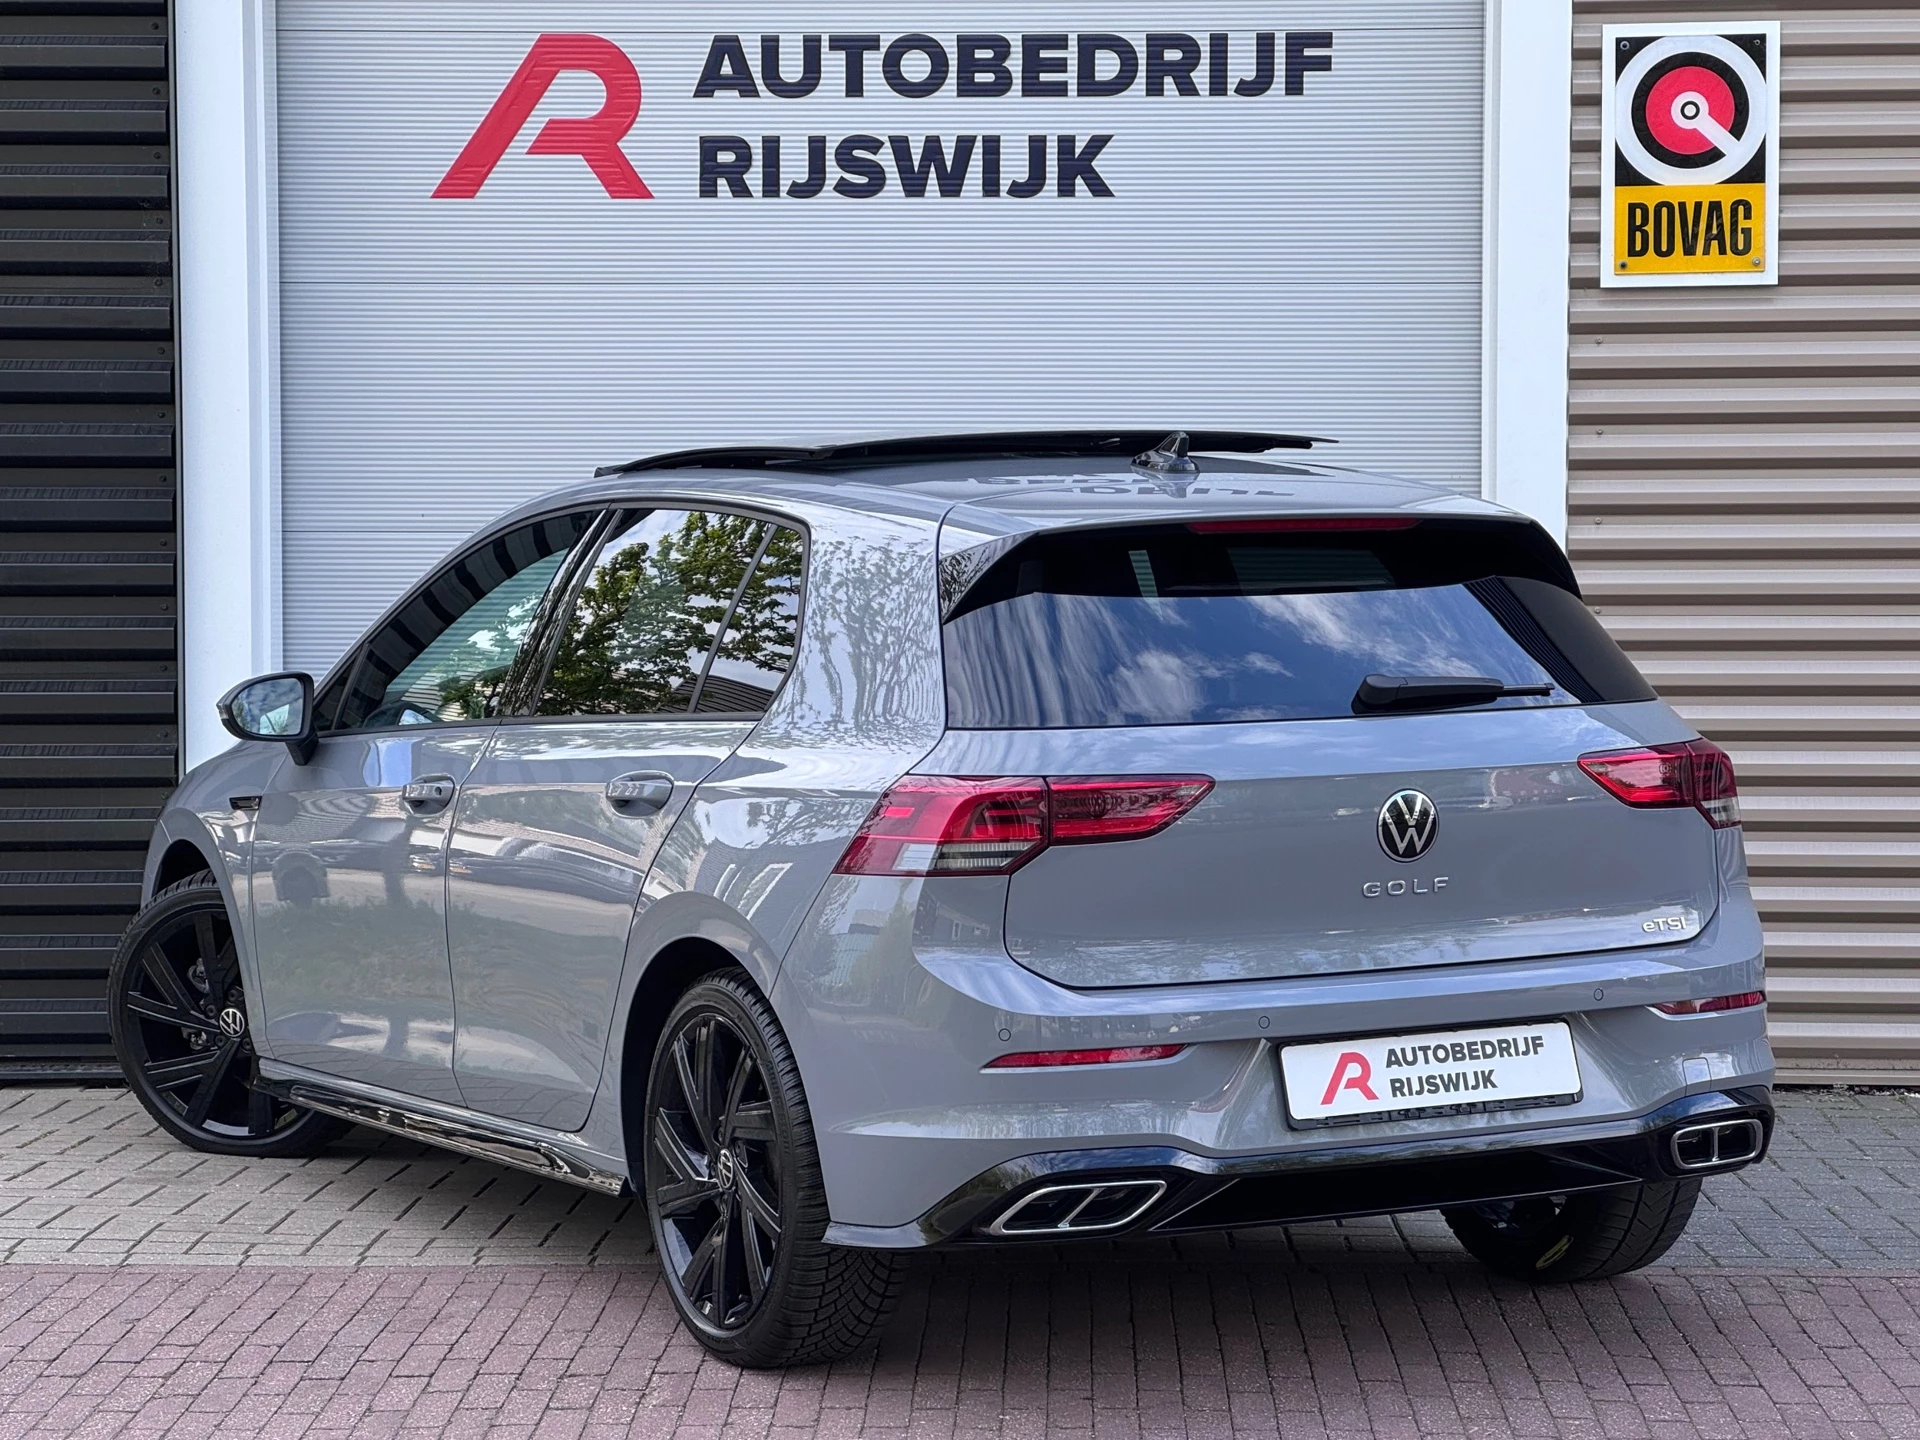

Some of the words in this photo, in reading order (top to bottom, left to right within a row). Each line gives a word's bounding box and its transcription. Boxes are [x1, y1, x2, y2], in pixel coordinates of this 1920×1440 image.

[692, 31, 1334, 99] AUTOBEDRIJF
[699, 134, 1116, 199] RIJSWIJK
[1627, 198, 1753, 258] BOVAG
[1362, 876, 1449, 898] GOLF
[1642, 916, 1687, 933] eTSI
[1385, 1035, 1545, 1069] AUTOBEDRIJF
[1389, 1069, 1498, 1098] RIJSWIJK
